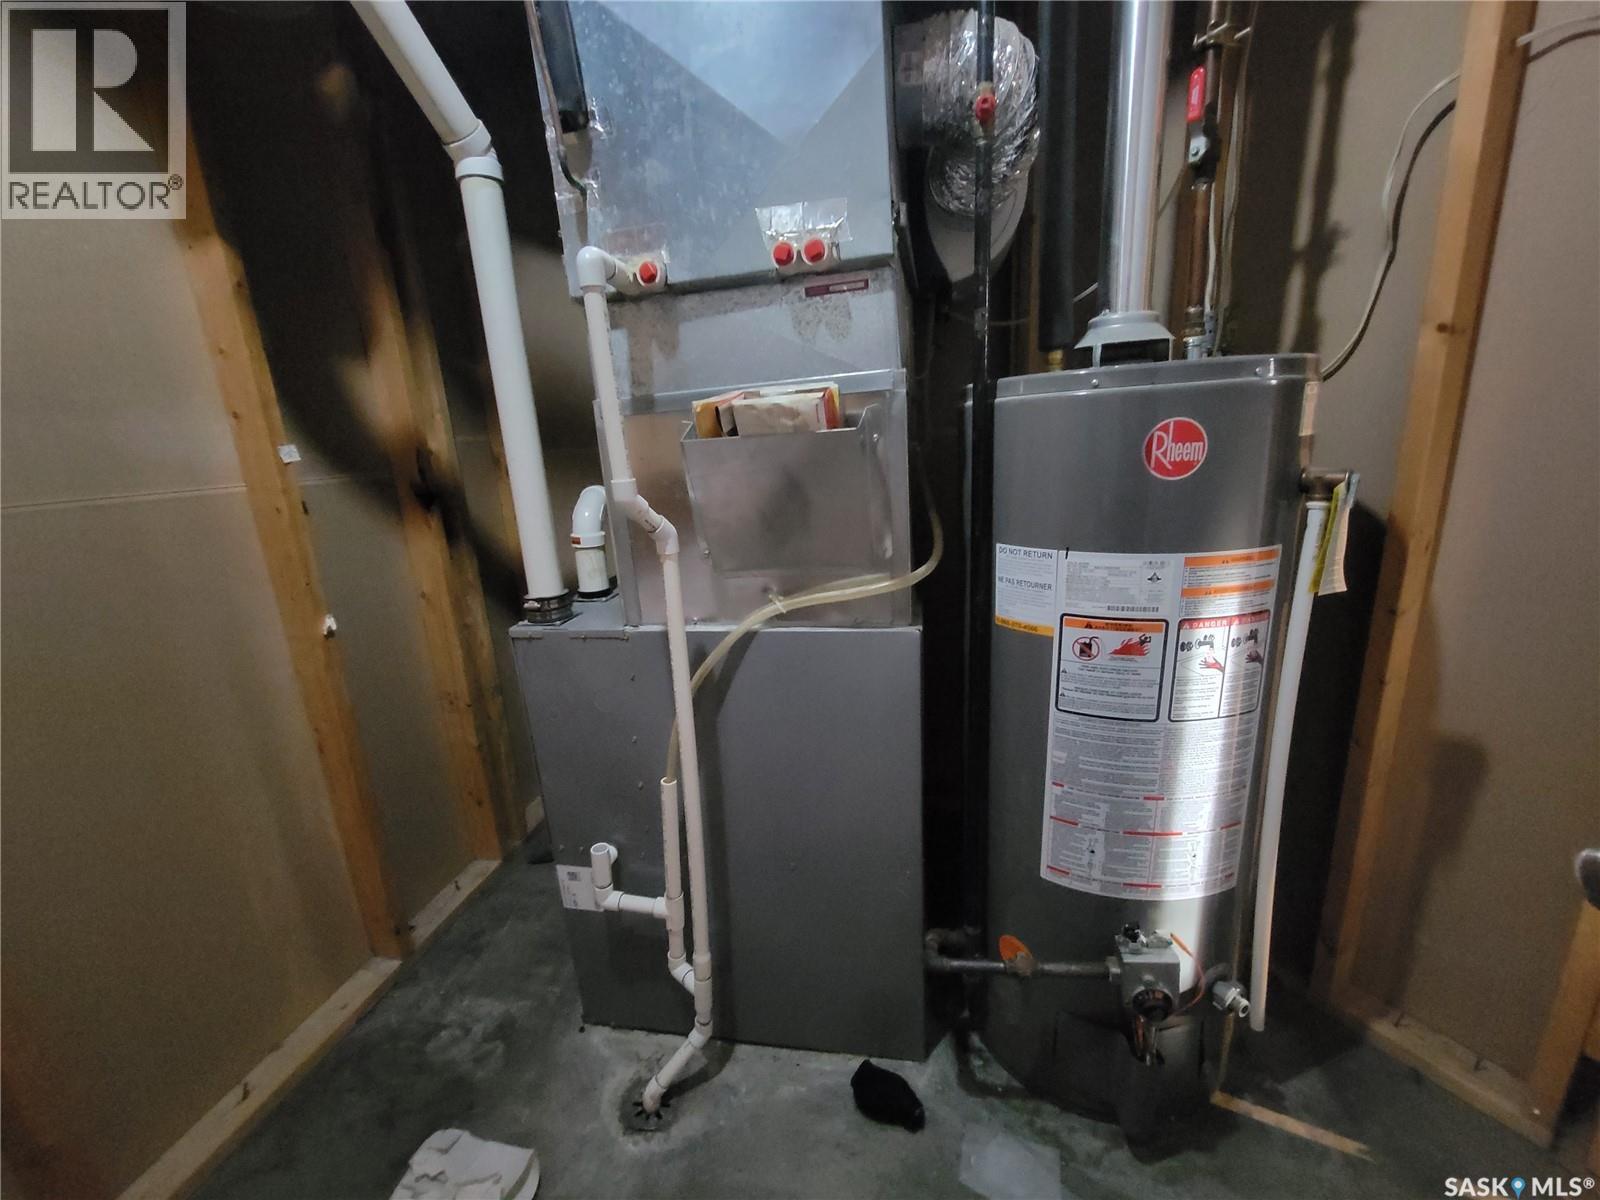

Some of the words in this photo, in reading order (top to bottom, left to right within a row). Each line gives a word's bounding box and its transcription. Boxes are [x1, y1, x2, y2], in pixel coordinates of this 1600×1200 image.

[1150, 420, 1204, 470] Rheem
[998, 546, 1008, 555] DO
[1008, 548, 1022, 557] NOT
[1023, 549, 1053, 560] RETURN
[1015, 579, 1052, 591] RETOURNER
[1192, 619, 1228, 629] DANGER
